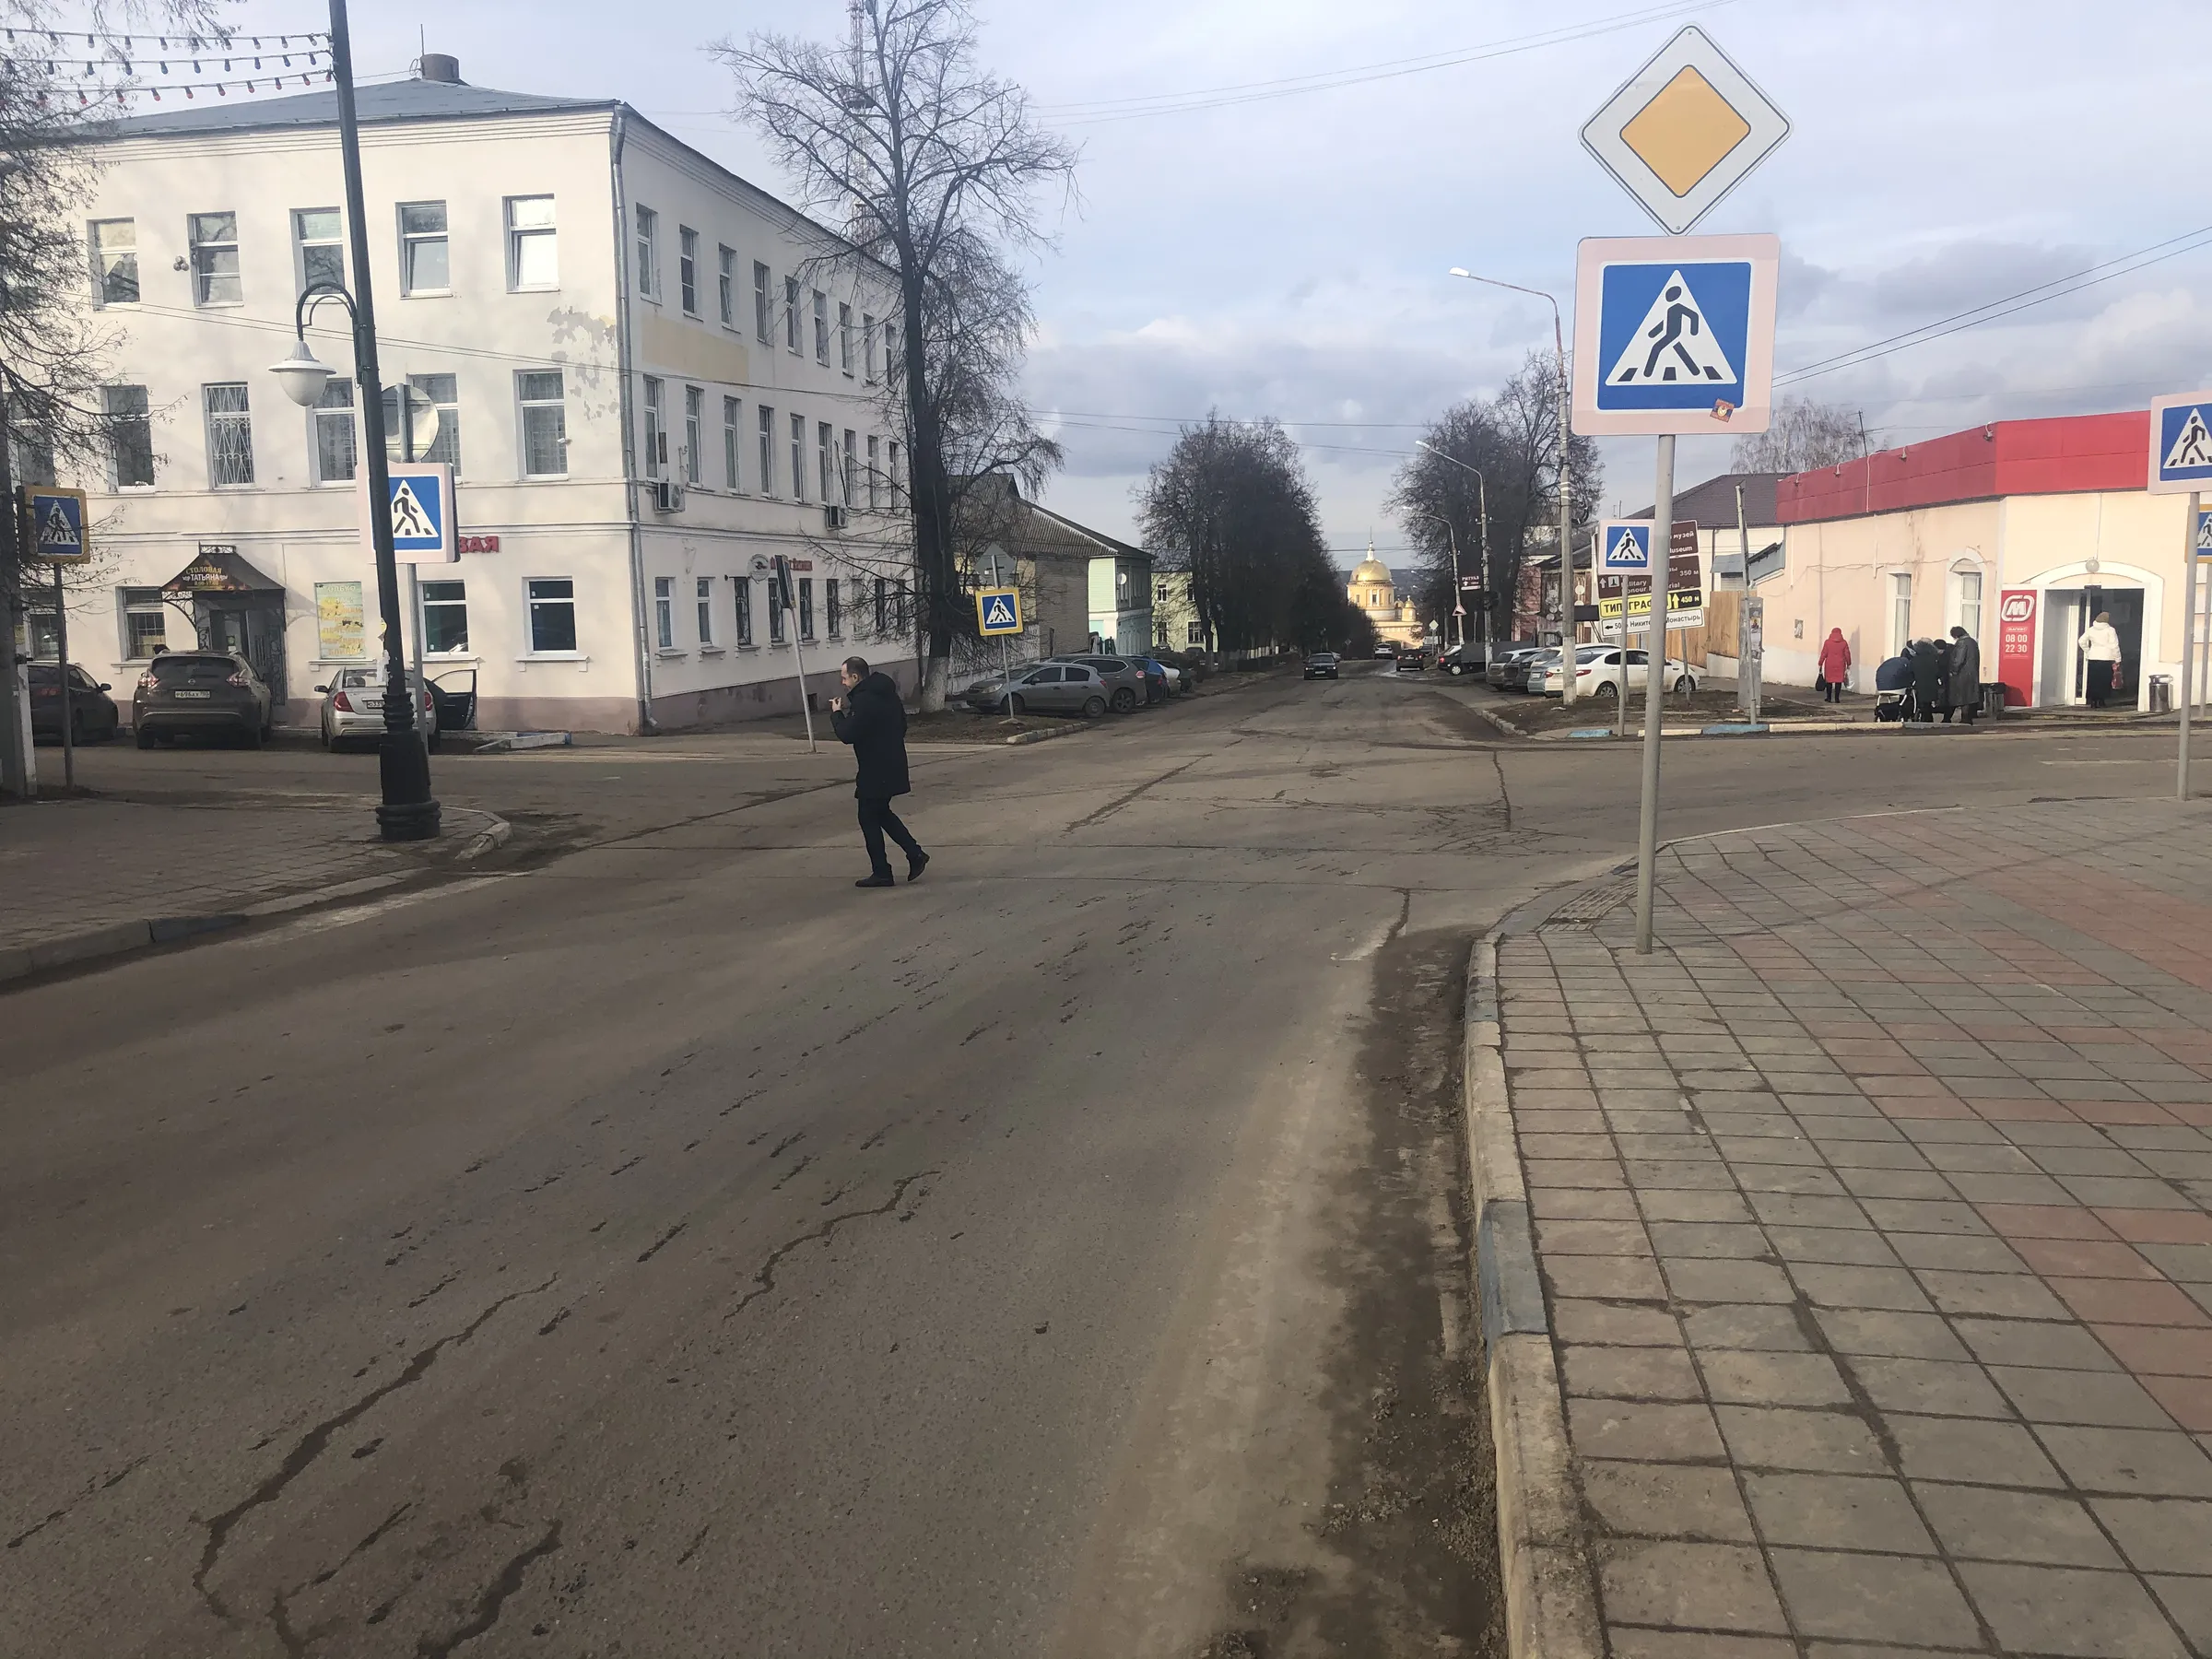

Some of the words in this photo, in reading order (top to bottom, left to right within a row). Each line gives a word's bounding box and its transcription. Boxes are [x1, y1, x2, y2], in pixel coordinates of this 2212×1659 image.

[1673, 531, 1694, 540] музей
[1669, 546, 1693, 554] useum
[185, 566, 222, 575] СТОЛОВАЯ
[190, 573, 222, 582] ТАТЬЯНА
[1628, 580, 1648, 588] litary
[2006, 634, 2016, 642] 08
[2018, 634, 2028, 642] 00
[2006, 644, 2016, 653] 22
[2018, 644, 2028, 653] 30
